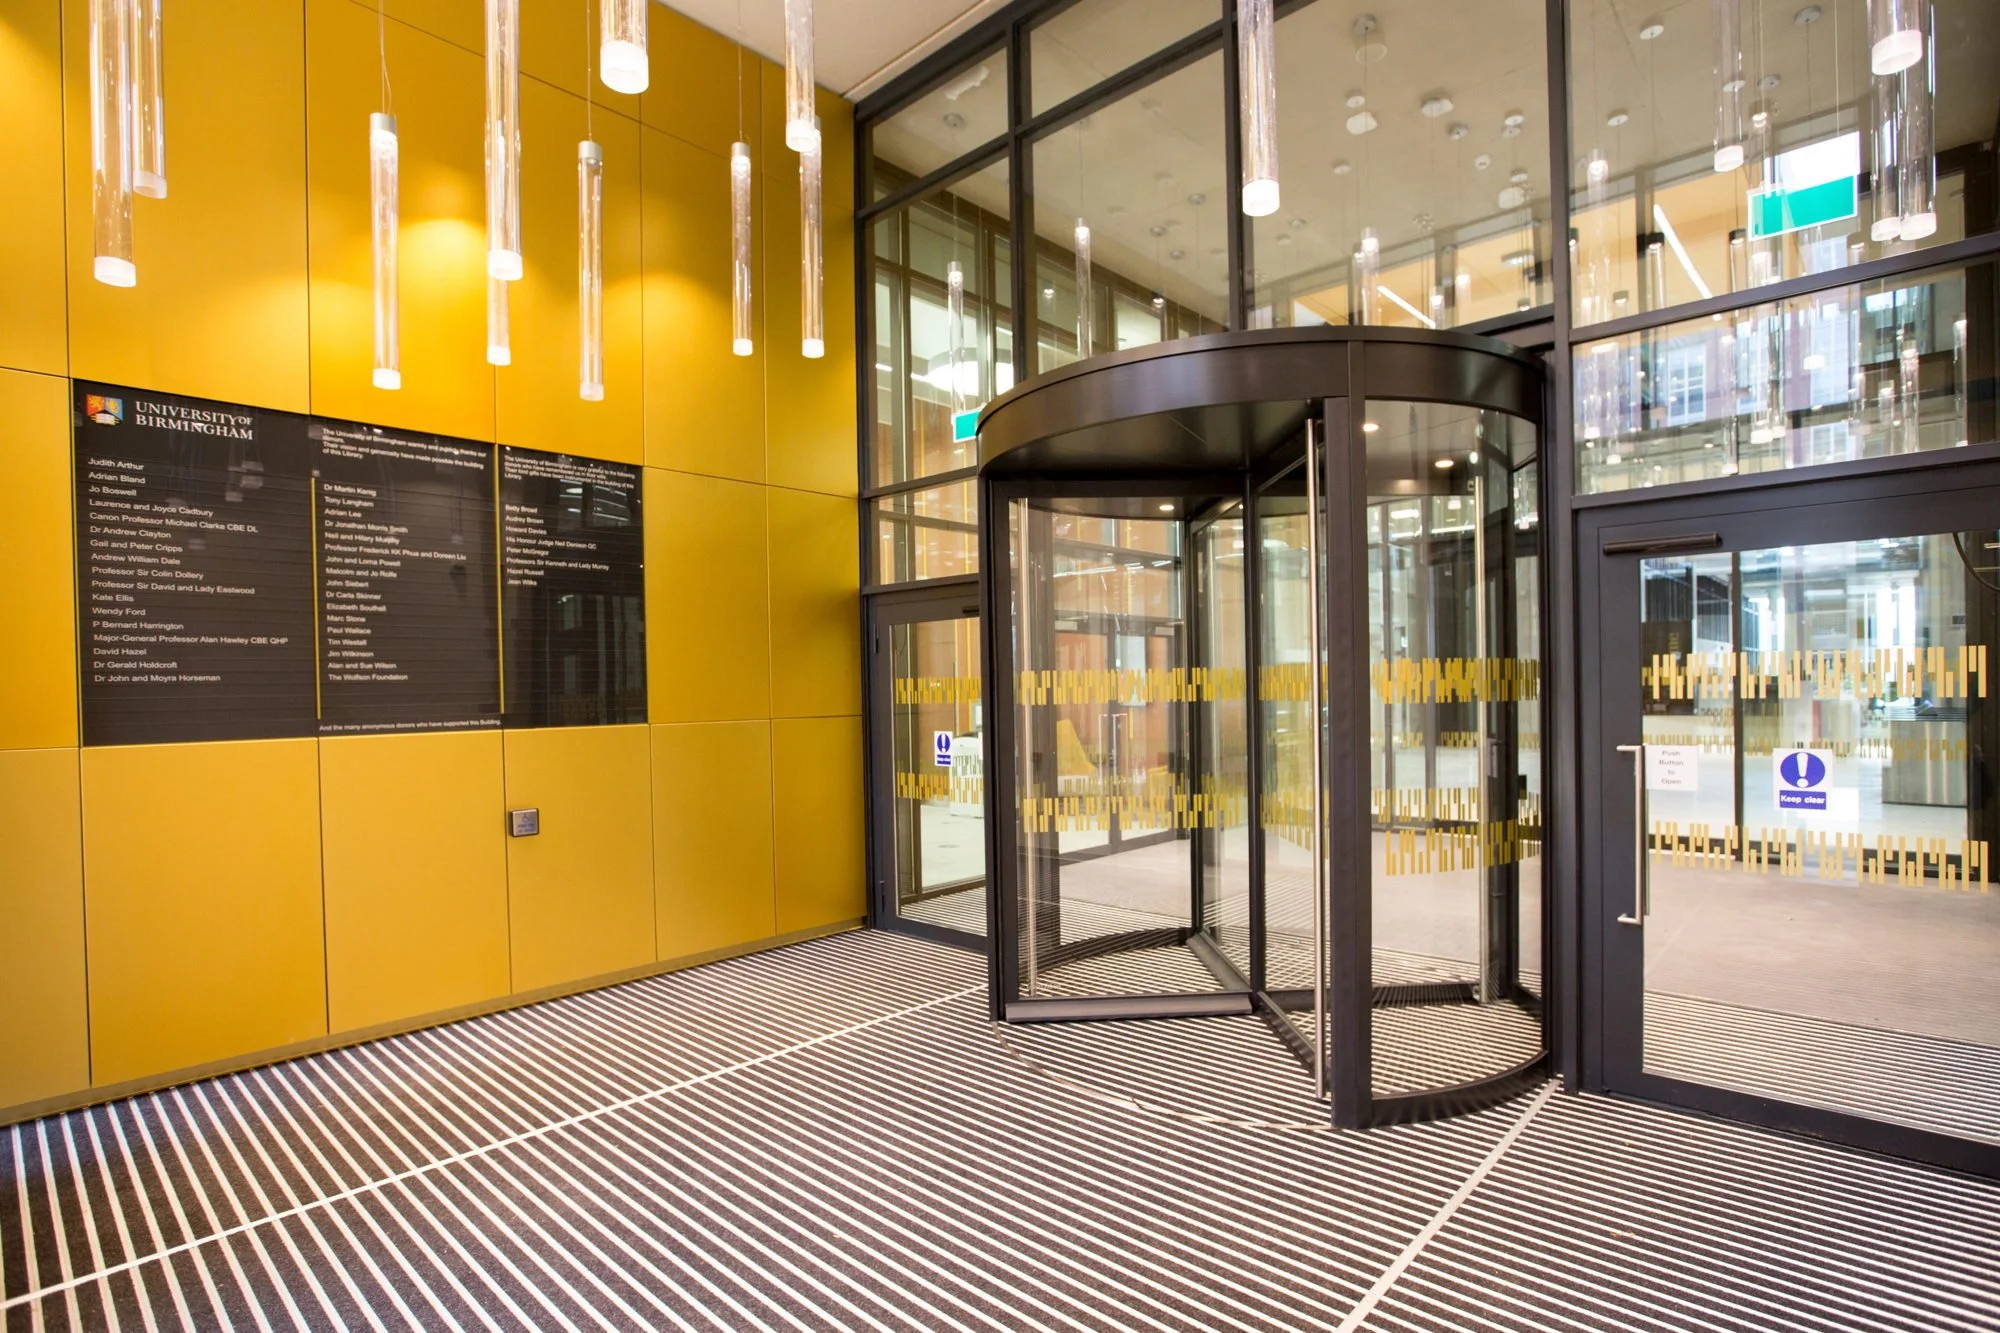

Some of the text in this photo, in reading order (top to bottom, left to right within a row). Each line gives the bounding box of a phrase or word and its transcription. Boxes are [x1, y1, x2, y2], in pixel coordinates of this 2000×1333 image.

[135, 401, 253, 426] UNIVERSITY OF
[136, 414, 253, 440] BIRMINGHAM
[88, 457, 144, 470] Judith Arthur
[88, 471, 118, 482] Adrian
[88, 485, 137, 497] Jo Boswell
[89, 498, 213, 519] Laurence and Joyce Cadbury
[90, 512, 258, 533] Canon Professor Michael Clarke CBE DL
[90, 525, 171, 540] Dr Andrew Clayton
[90, 539, 182, 554] Gail and Peter Cripps
[91, 553, 181, 565] Andrew William Dale
[92, 567, 134, 576] Professor
[136, 569, 148, 577] Sir
[150, 570, 173, 578] Colin
[92, 580, 134, 589] Professor
[150, 583, 175, 591] David
[177, 584, 193, 592] and
[194, 584, 214, 594] Lady
[216, 585, 255, 594] Eastwood
[92, 593, 134, 602] Kate Ellis
[92, 607, 123, 617] Wendy
[102, 621, 137, 629] Bernard
[139, 622, 184, 632] Harrington
[94, 634, 156, 644] Major-General
[158, 635, 198, 643] Professor
[219, 636, 248, 646] Hawley
[150, 674, 176, 684] Moyra
[1781, 795, 1801, 804] Keep
